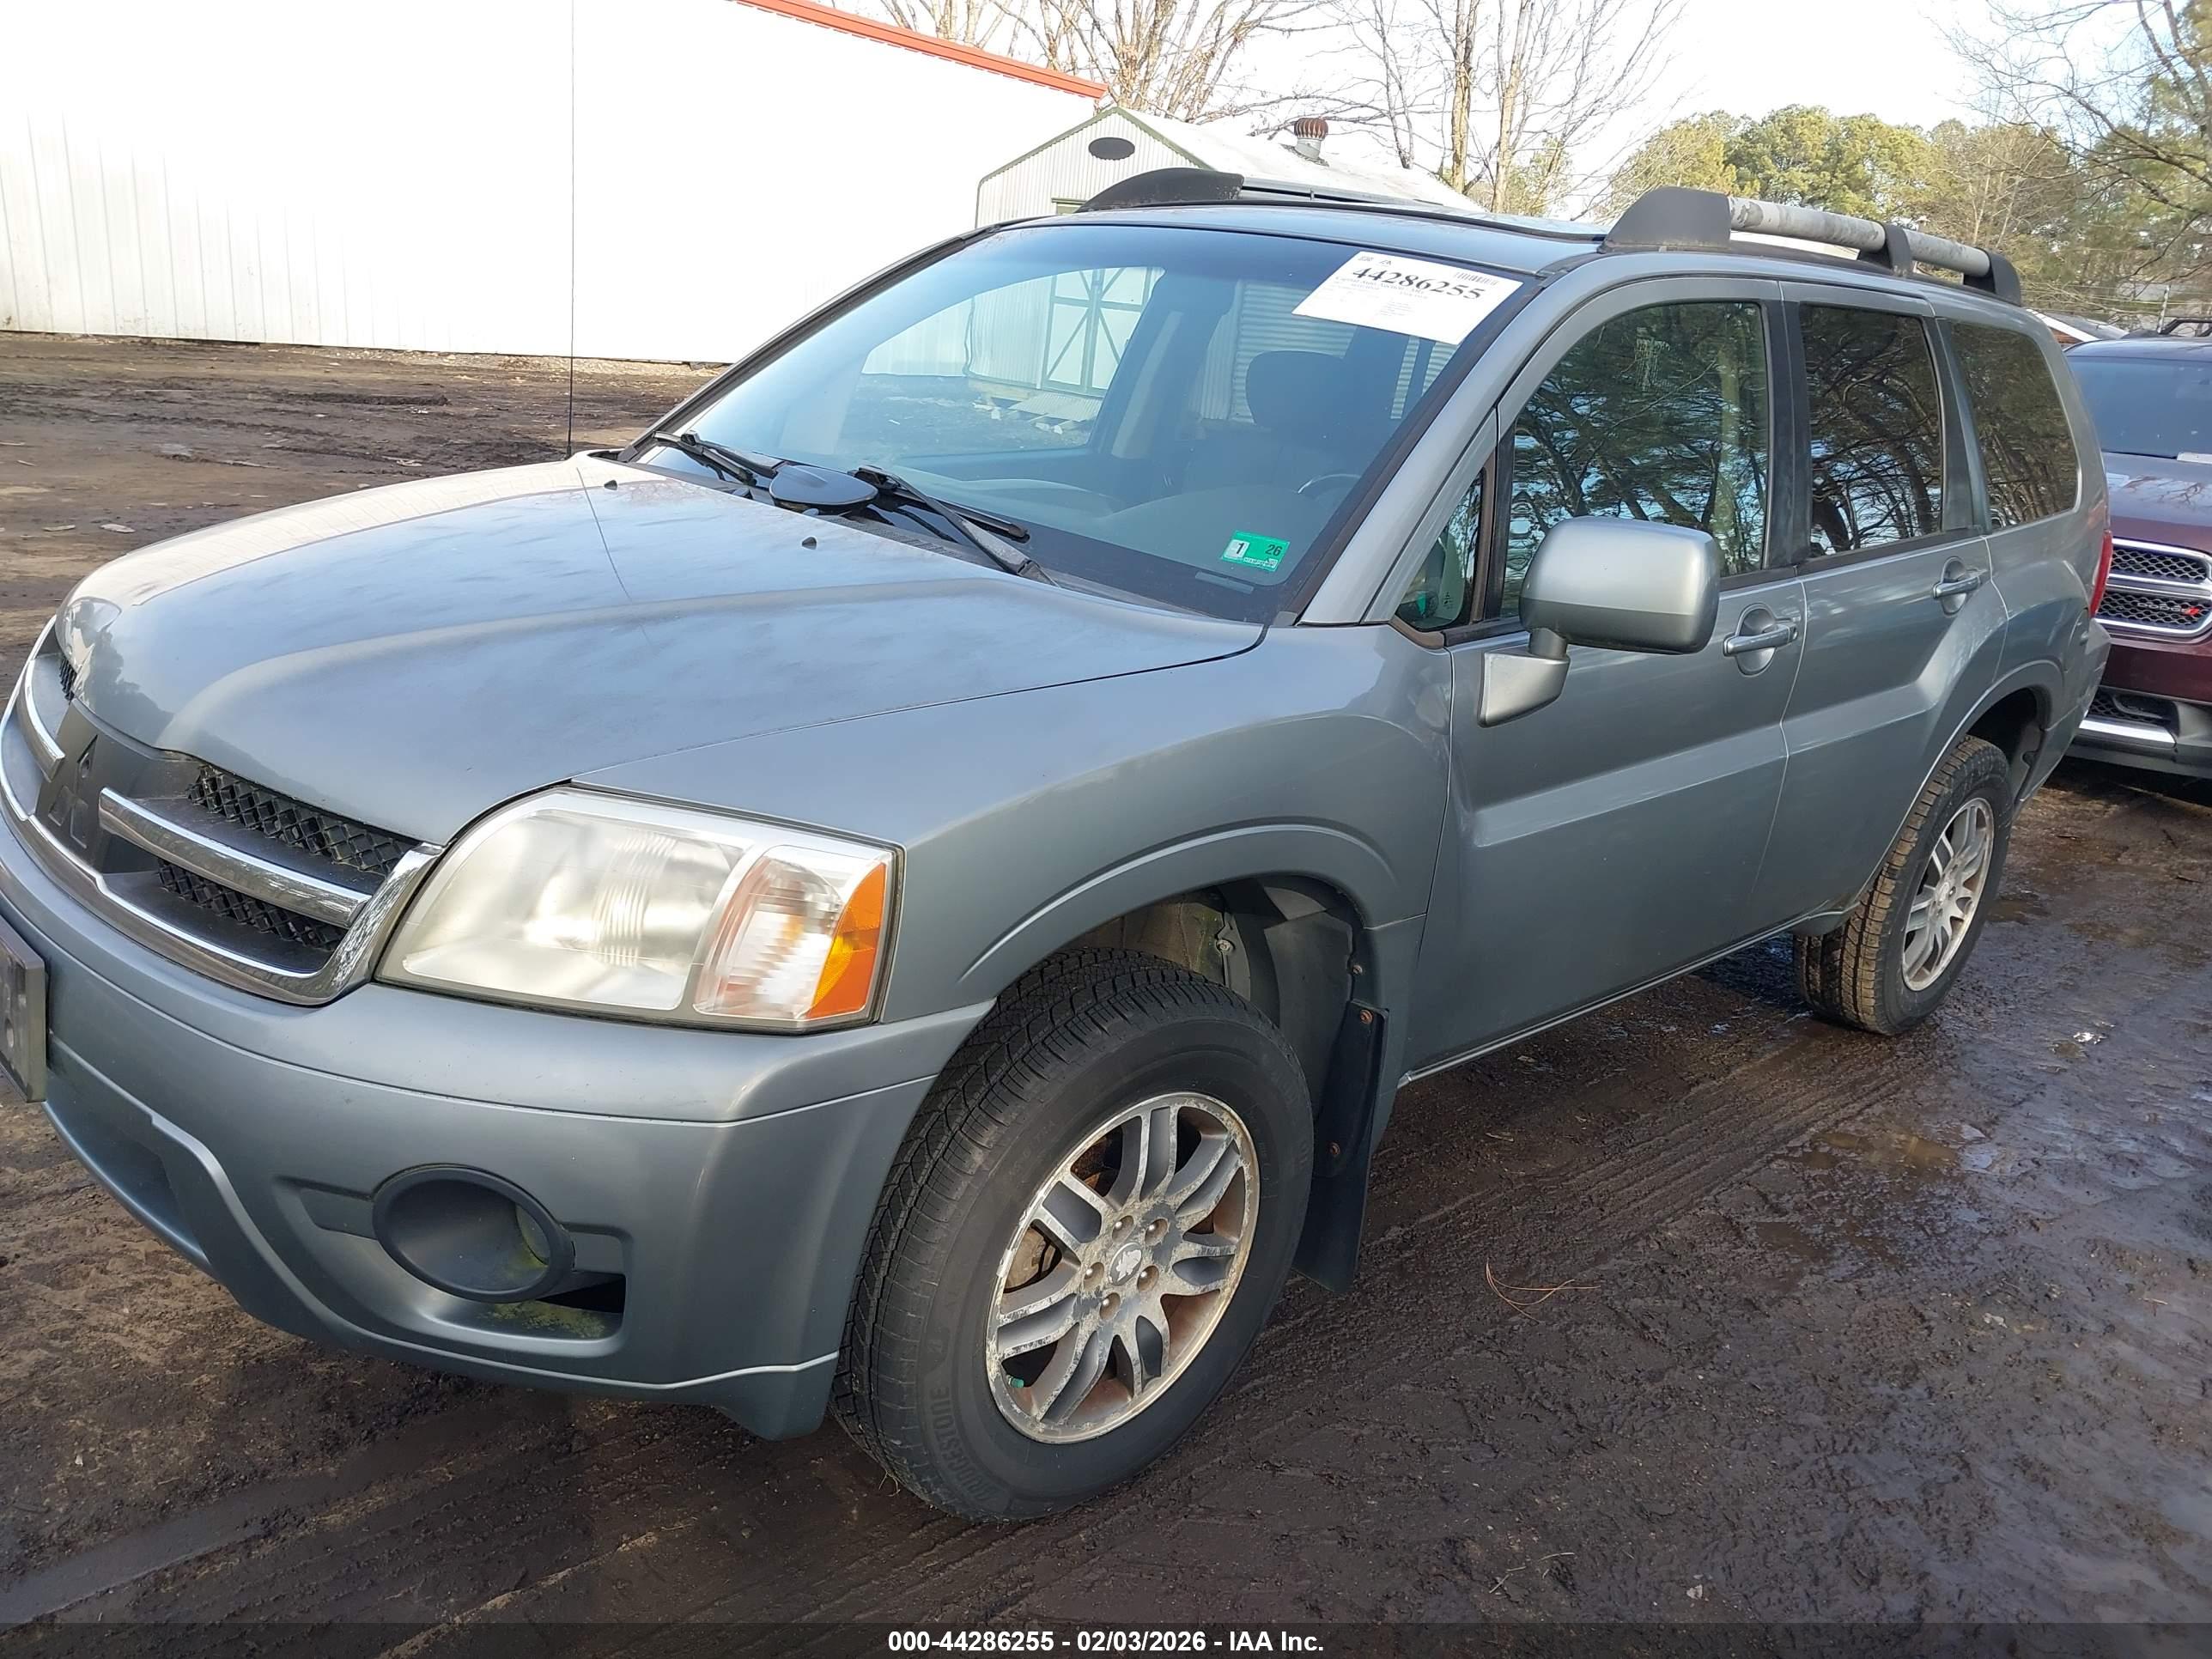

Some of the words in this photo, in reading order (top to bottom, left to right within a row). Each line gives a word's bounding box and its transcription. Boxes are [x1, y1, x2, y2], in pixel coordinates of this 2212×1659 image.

[1352, 266, 1486, 301] 44286255
[1237, 542, 1245, 555] 1
[1265, 544, 1283, 556] 26
